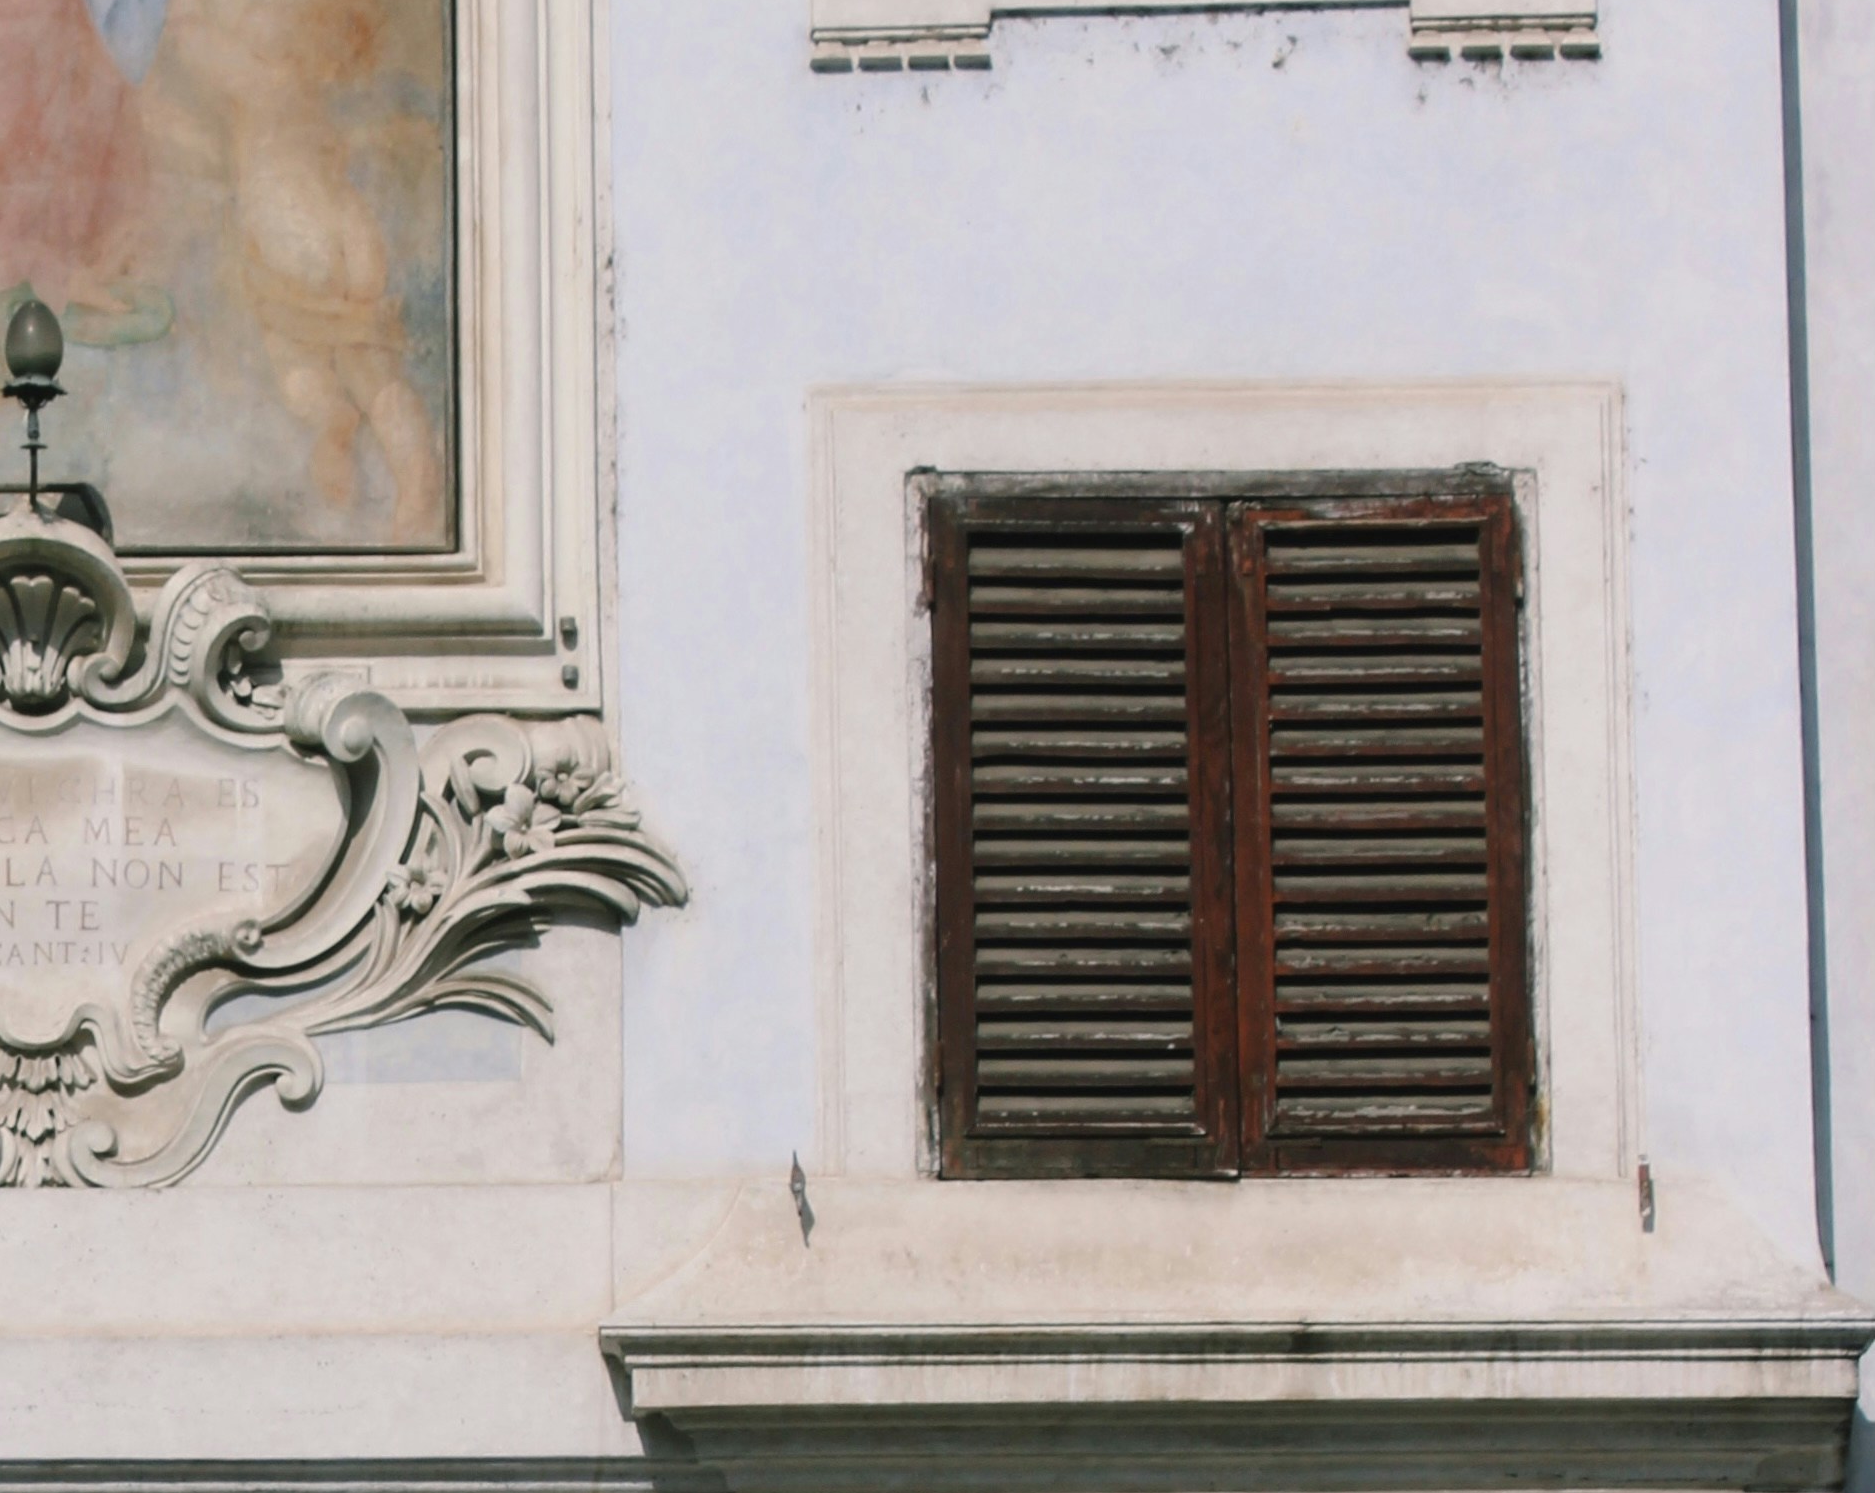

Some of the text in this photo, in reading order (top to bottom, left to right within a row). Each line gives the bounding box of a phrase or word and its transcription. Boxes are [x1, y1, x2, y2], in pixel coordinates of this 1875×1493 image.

[217, 777, 261, 808] ES
[83, 816, 178, 846] MEA
[91, 857, 183, 890] NON
[217, 861, 290, 893] EST
[45, 900, 101, 932] TE
